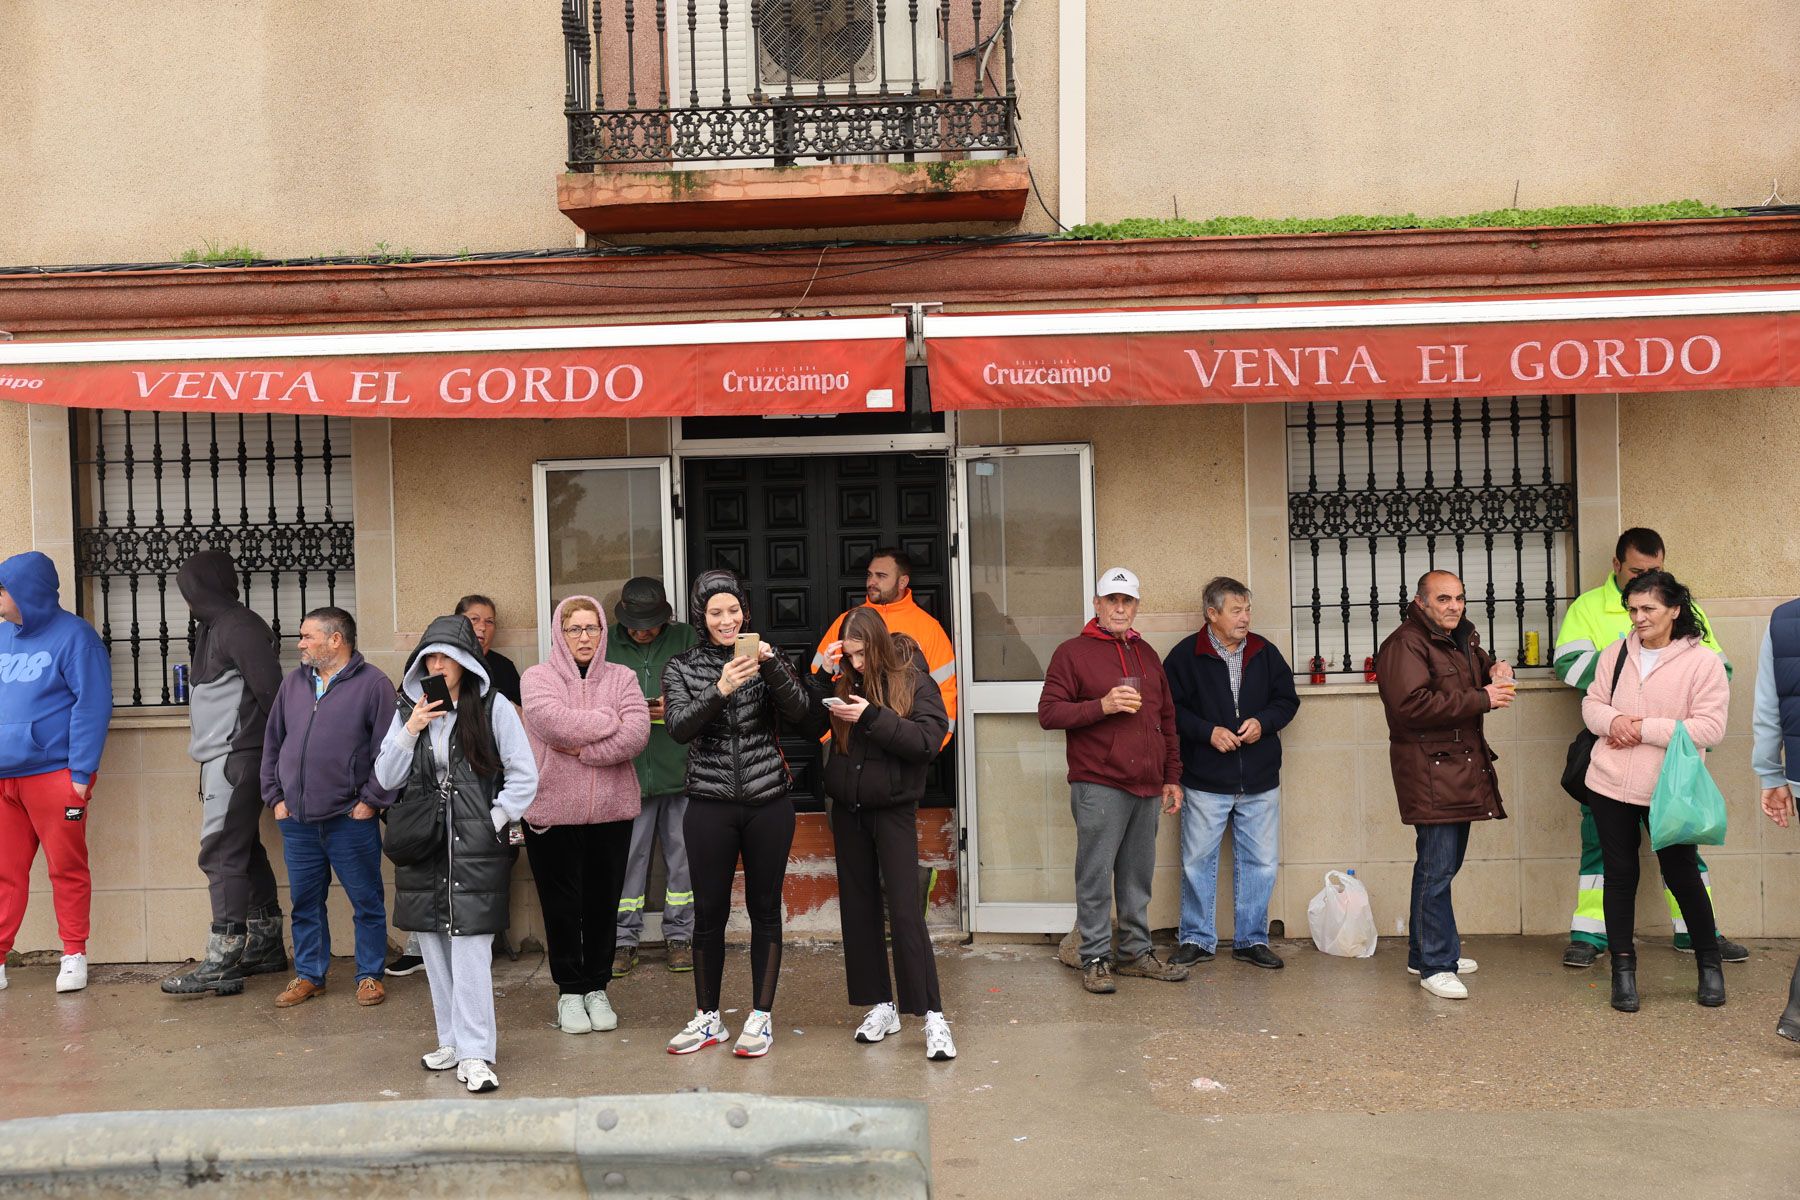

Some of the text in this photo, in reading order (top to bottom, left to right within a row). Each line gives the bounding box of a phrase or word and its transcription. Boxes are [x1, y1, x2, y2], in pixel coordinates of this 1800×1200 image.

[982, 362, 1111, 387] Cruzcampo
[1184, 334, 1721, 388] VENTA EL GORDO
[132, 364, 644, 404] VENTA EL GORDO
[722, 369, 849, 394] Cruzcampo
